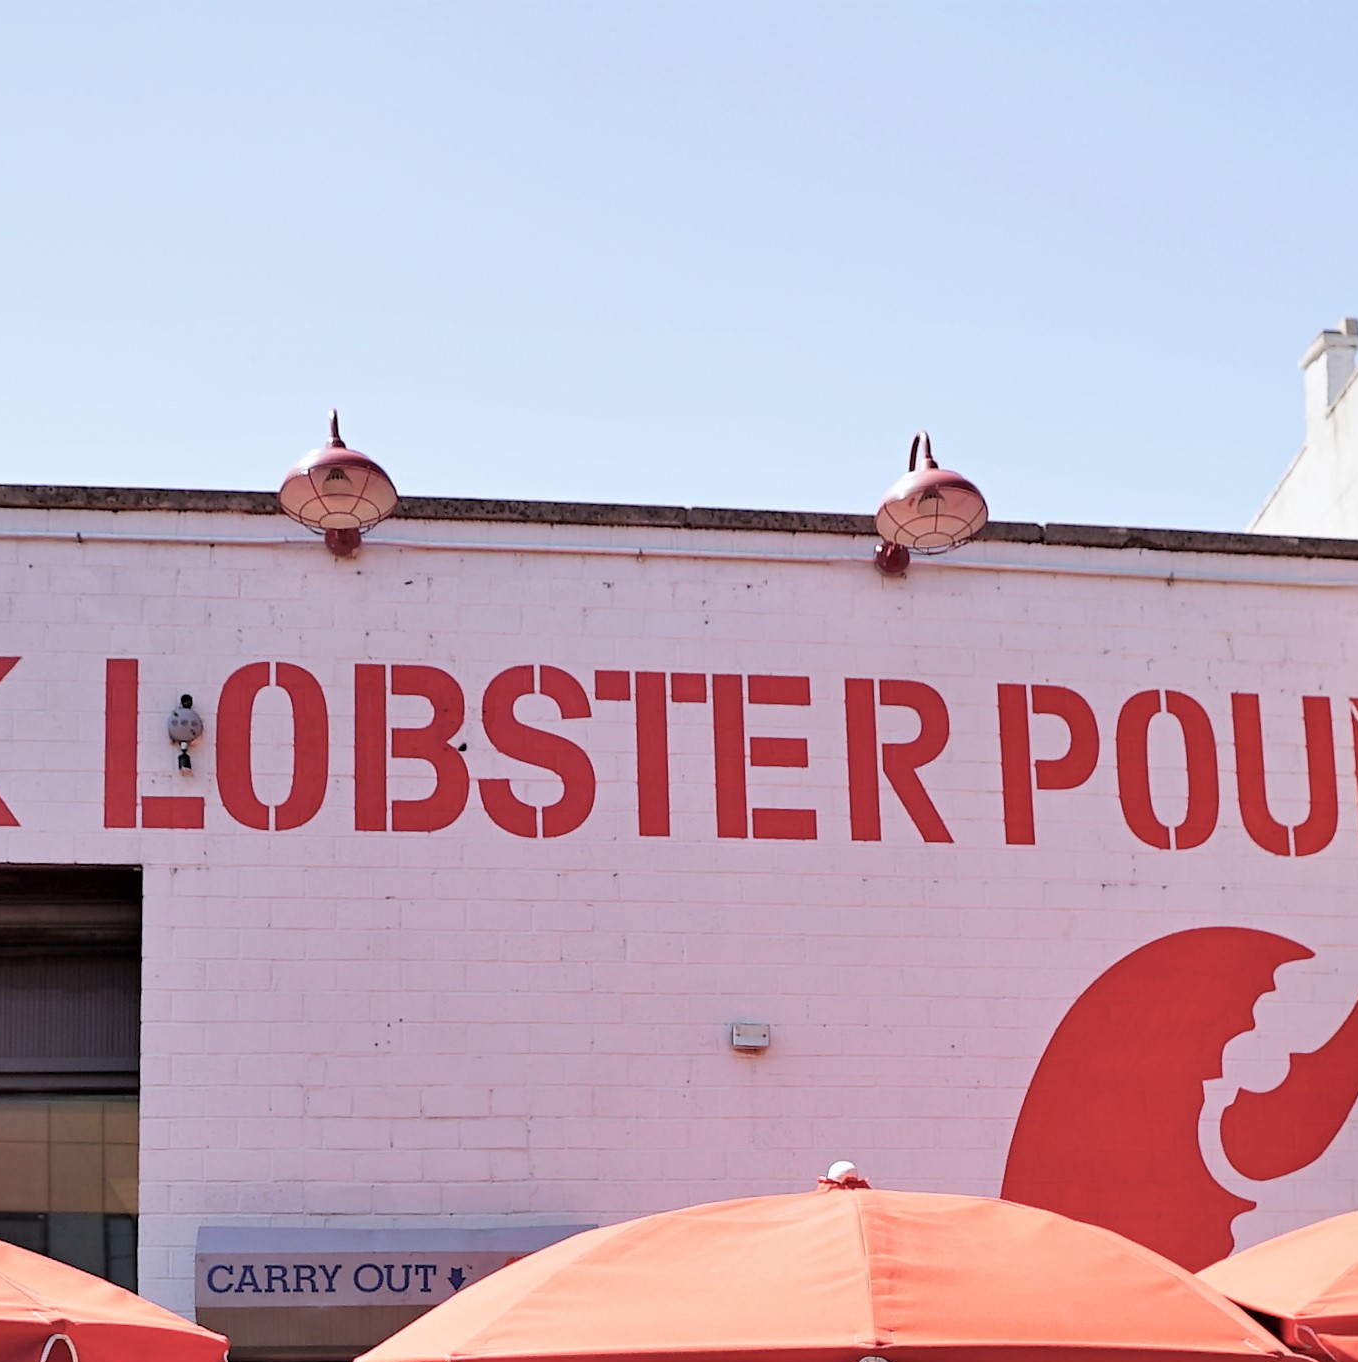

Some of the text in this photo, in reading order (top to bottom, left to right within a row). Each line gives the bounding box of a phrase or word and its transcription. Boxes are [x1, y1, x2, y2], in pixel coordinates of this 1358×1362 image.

[103, 658, 953, 842] LOBSTER
[207, 1264, 437, 1293] CARRY OUT
